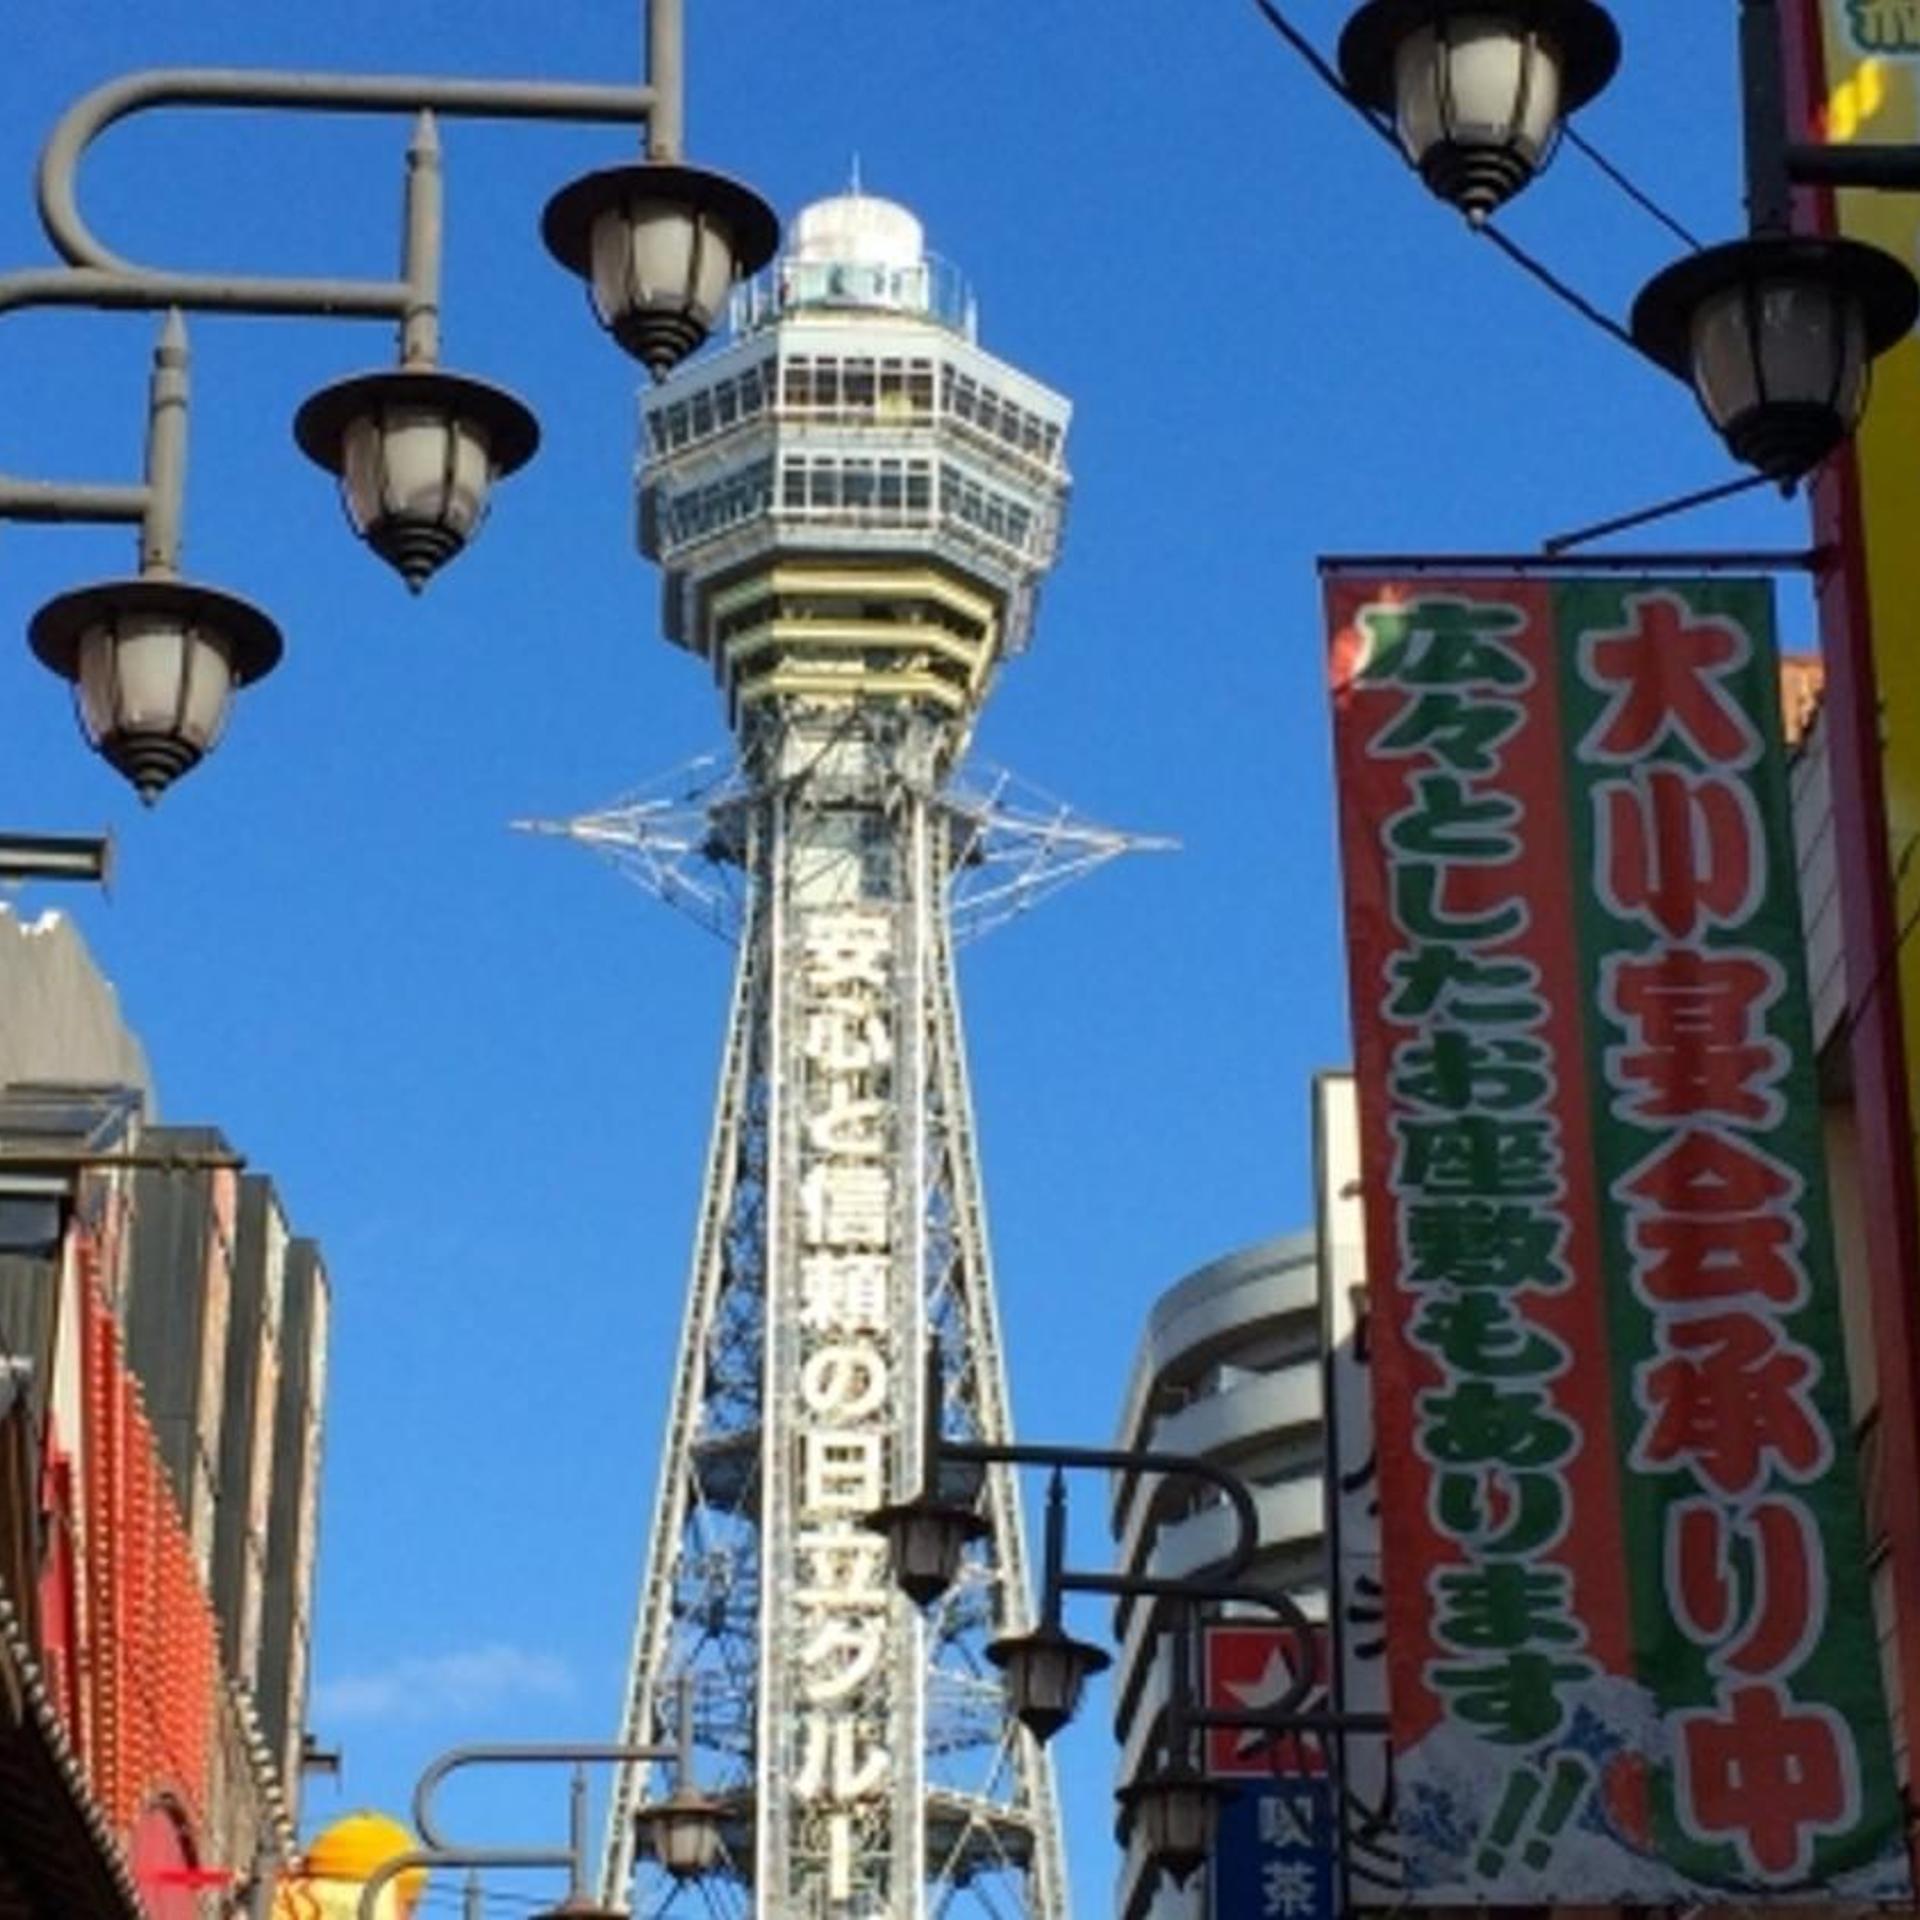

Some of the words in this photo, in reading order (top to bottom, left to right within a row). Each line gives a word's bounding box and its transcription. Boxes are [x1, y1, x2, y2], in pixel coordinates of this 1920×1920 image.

[1577, 590, 1862, 1886] 大小宴会承り中
